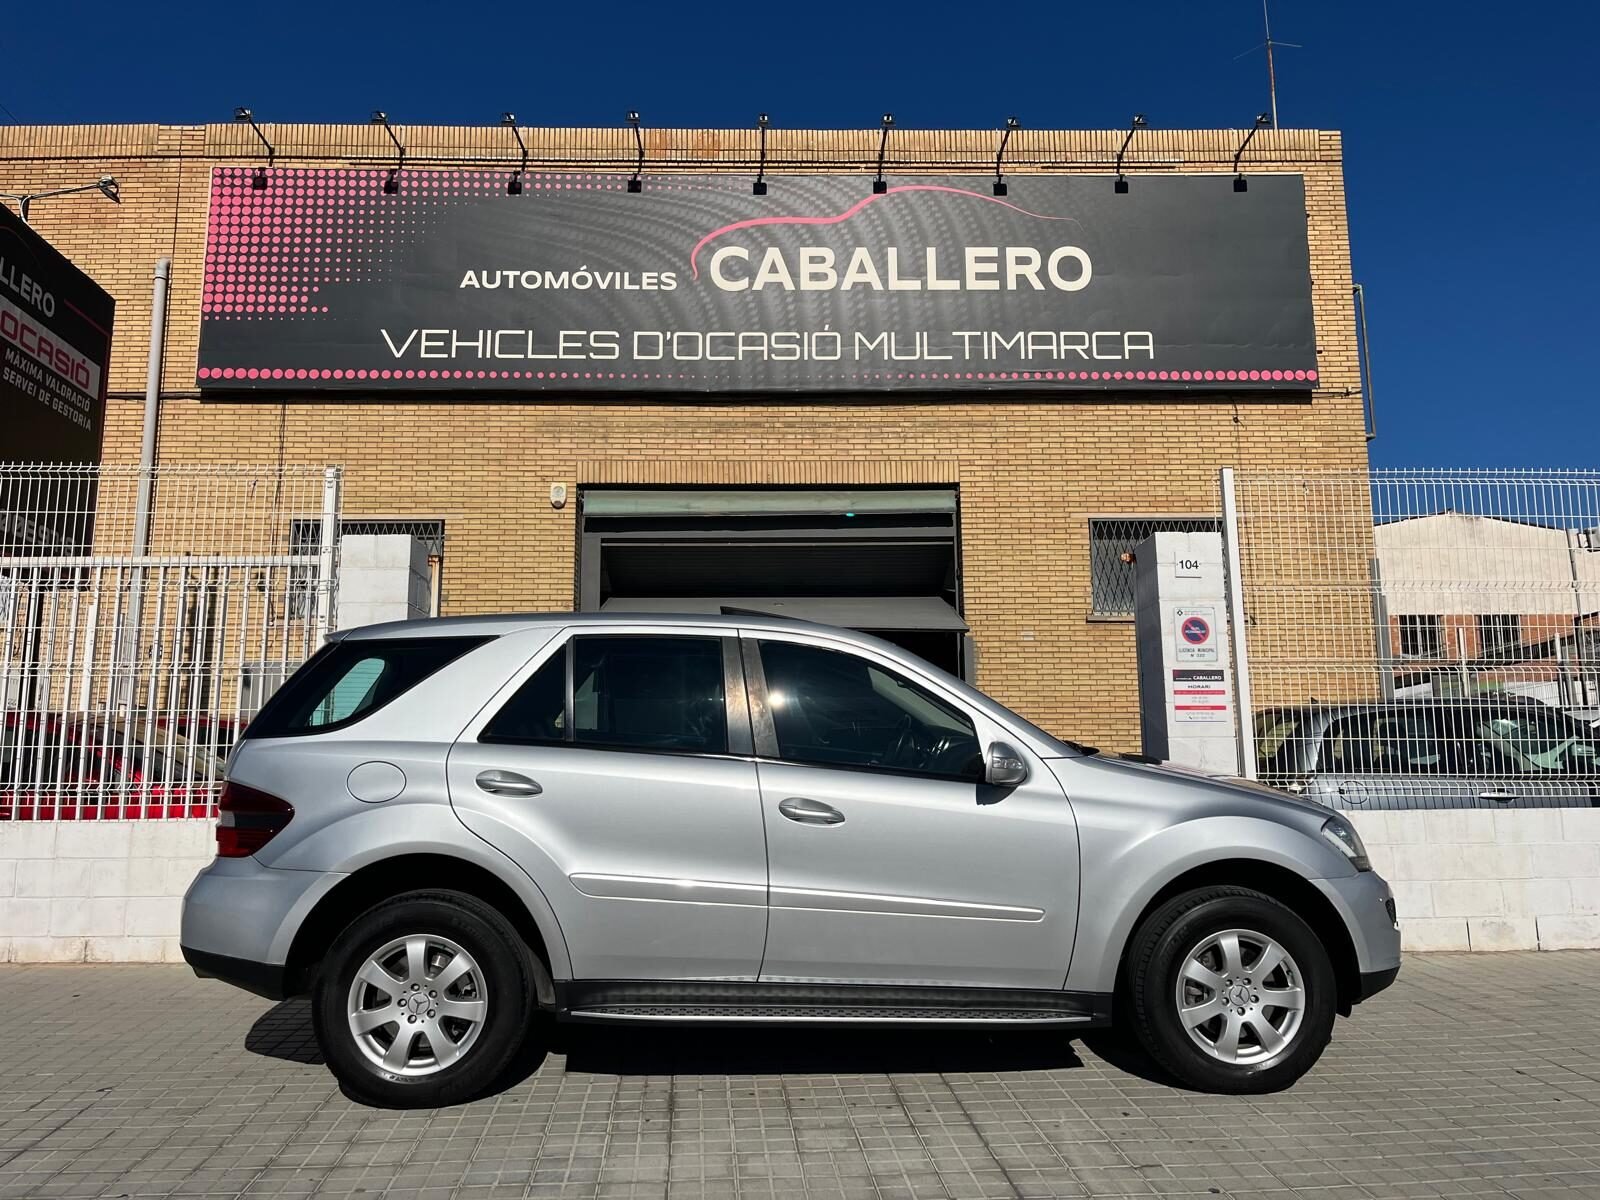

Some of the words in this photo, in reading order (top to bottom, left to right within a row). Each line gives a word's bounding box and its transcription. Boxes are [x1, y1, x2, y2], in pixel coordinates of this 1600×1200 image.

[459, 264, 678, 292] AUTOMÓVILES
[709, 246, 1092, 292] CABALLERO
[1, 310, 90, 390] OCASIÓ
[381, 328, 620, 361] VEHICLES
[633, 325, 841, 362] D'OCASIÓ
[854, 331, 1155, 361] MULTIMARCA
[2, 366, 37, 398] SERVEI
[38, 388, 51, 406] DE
[52, 397, 92, 432] GESTORIA
[45, 373, 91, 413] VALORACIÓ
[1179, 560, 1199, 570] 104
